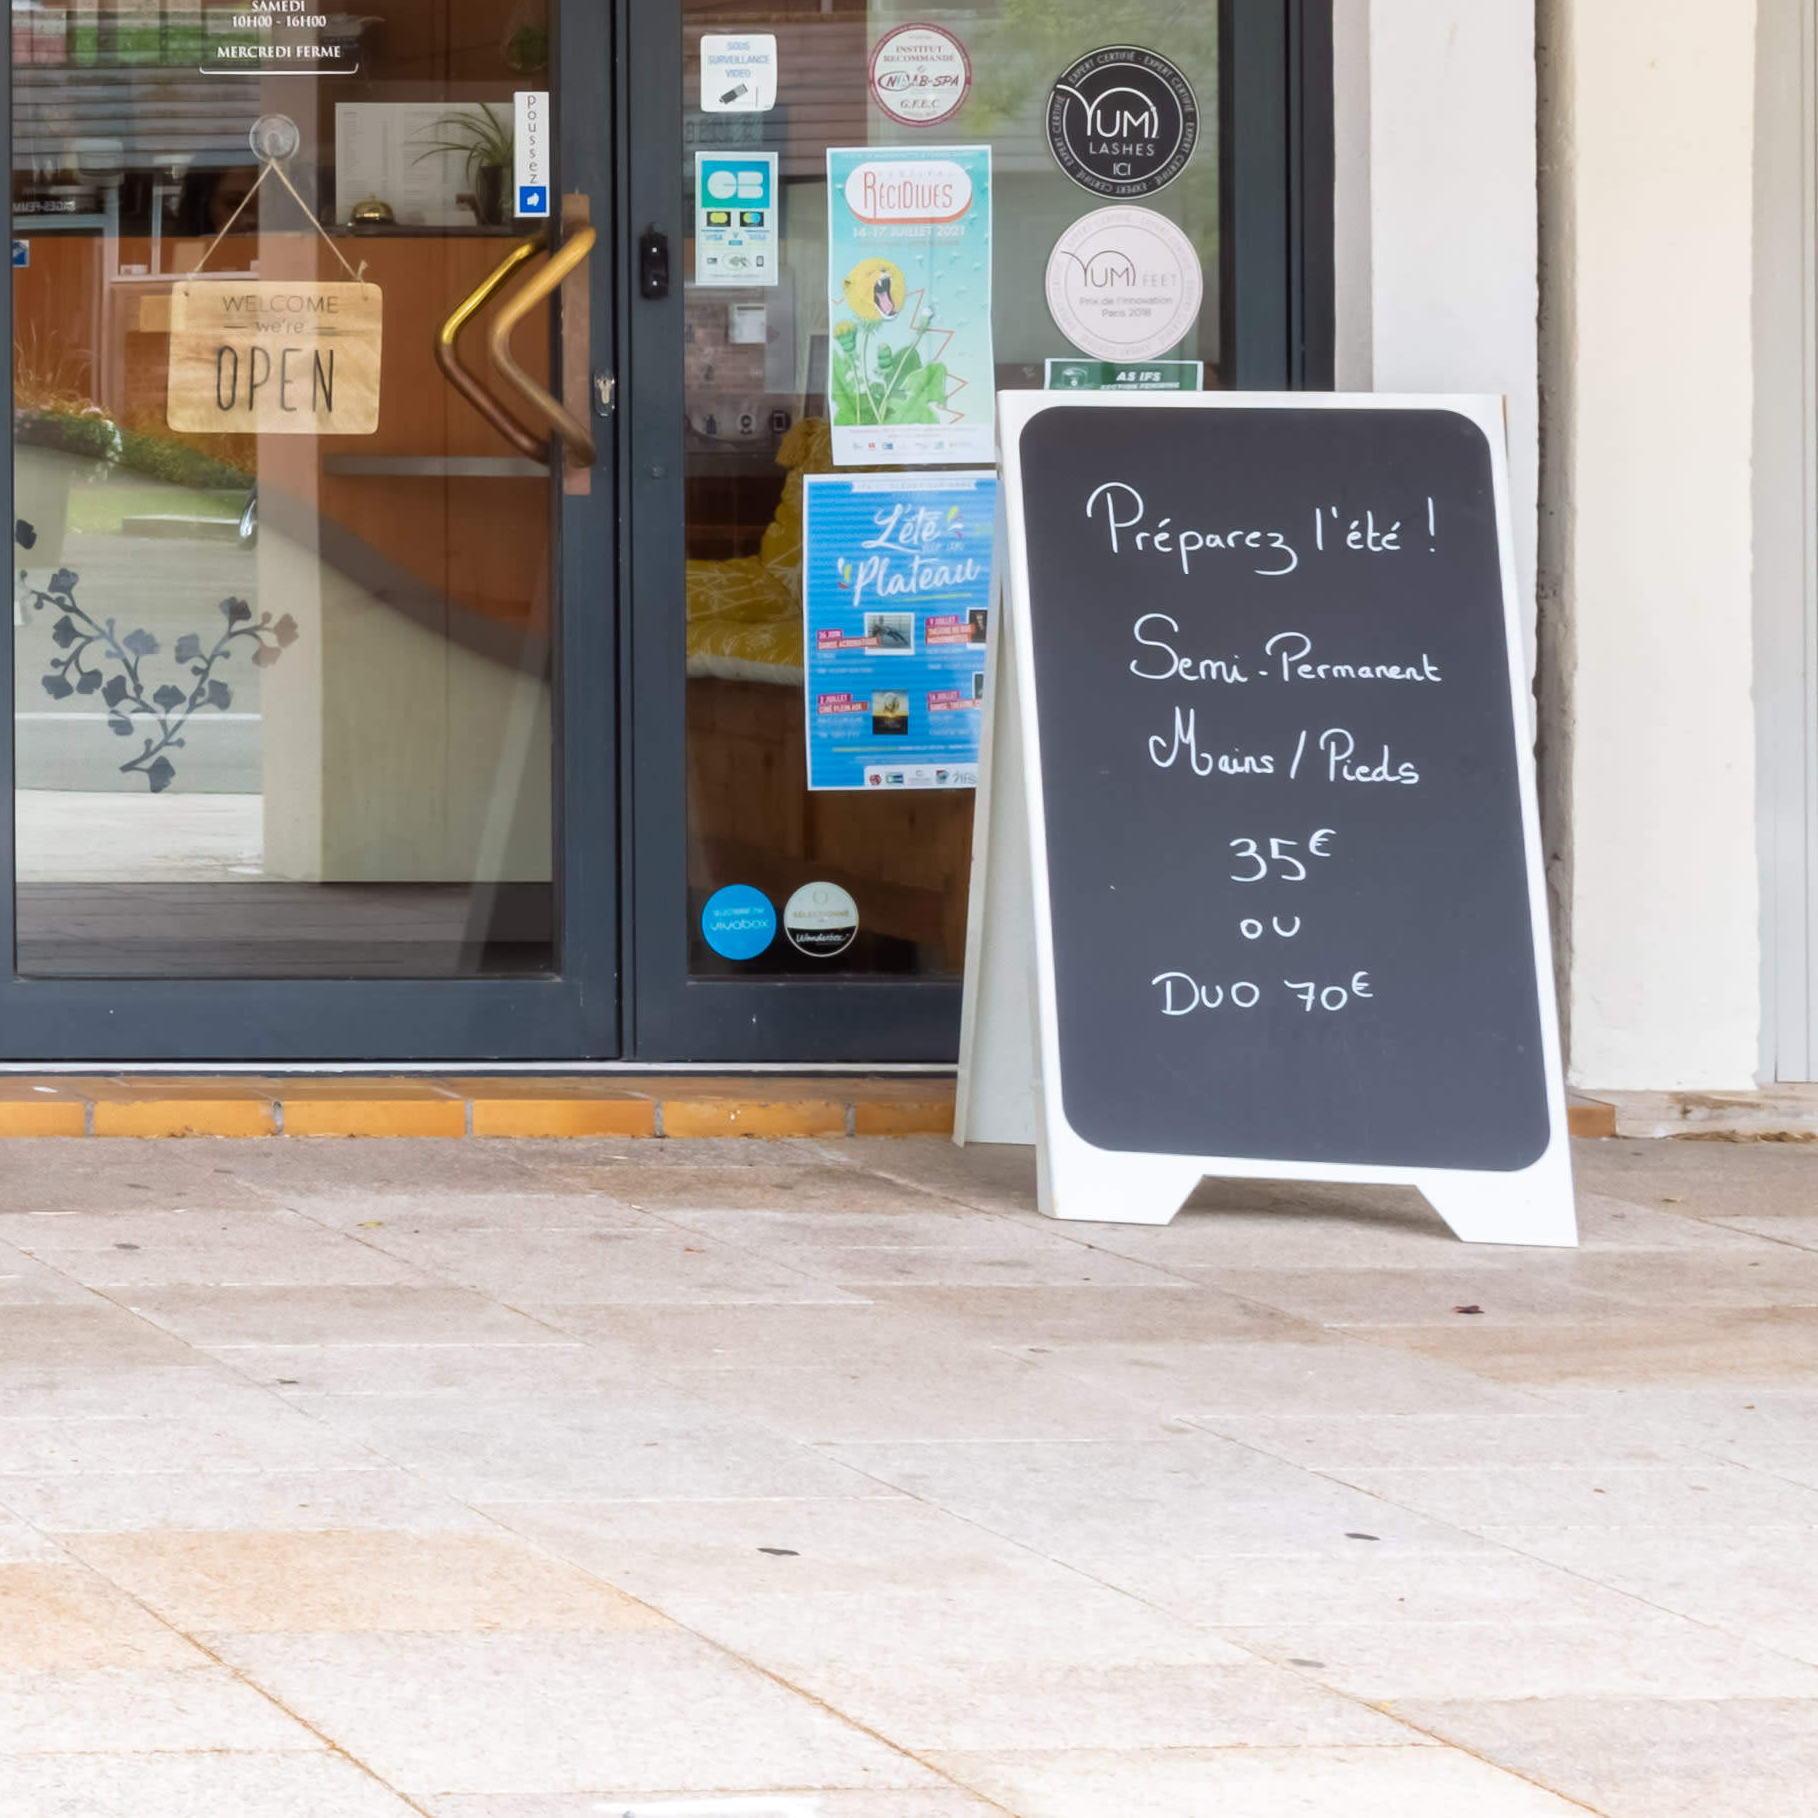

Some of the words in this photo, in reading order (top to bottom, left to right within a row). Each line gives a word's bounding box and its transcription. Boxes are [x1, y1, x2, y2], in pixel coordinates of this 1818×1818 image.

[251, 0, 305, 12] SAMEDI
[232, 15, 273, 28] 10H00
[286, 15, 326, 28] 16H00
[217, 45, 292, 58] MERCREDI
[296, 45, 341, 58] FERME
[708, 55, 771, 65] SURVEILLANCE
[1067, 60, 1095, 83] EXPERT
[1143, 55, 1173, 80] EXPERT
[1089, 141, 1155, 157] LASHES
[1112, 162, 1132, 177] ICI
[1142, 273, 1178, 288] FEET
[223, 294, 340, 314] WELCOME
[255, 318, 305, 333] we're
[216, 345, 334, 413] OPEN
[1116, 371, 1135, 382] AS
[1139, 371, 1162, 382] IFS
[861, 503, 944, 554] L'été
[1086, 481, 1298, 576] Préparez
[1315, 505, 1402, 553] l'été
[1426, 496, 1437, 553] !
[853, 554, 981, 608] Plateau
[1148, 705, 1274, 776] Mains
[1319, 727, 1420, 785] Pieds
[1229, 827, 1338, 883] 35€
[1284, 970, 1374, 1014] 70€
